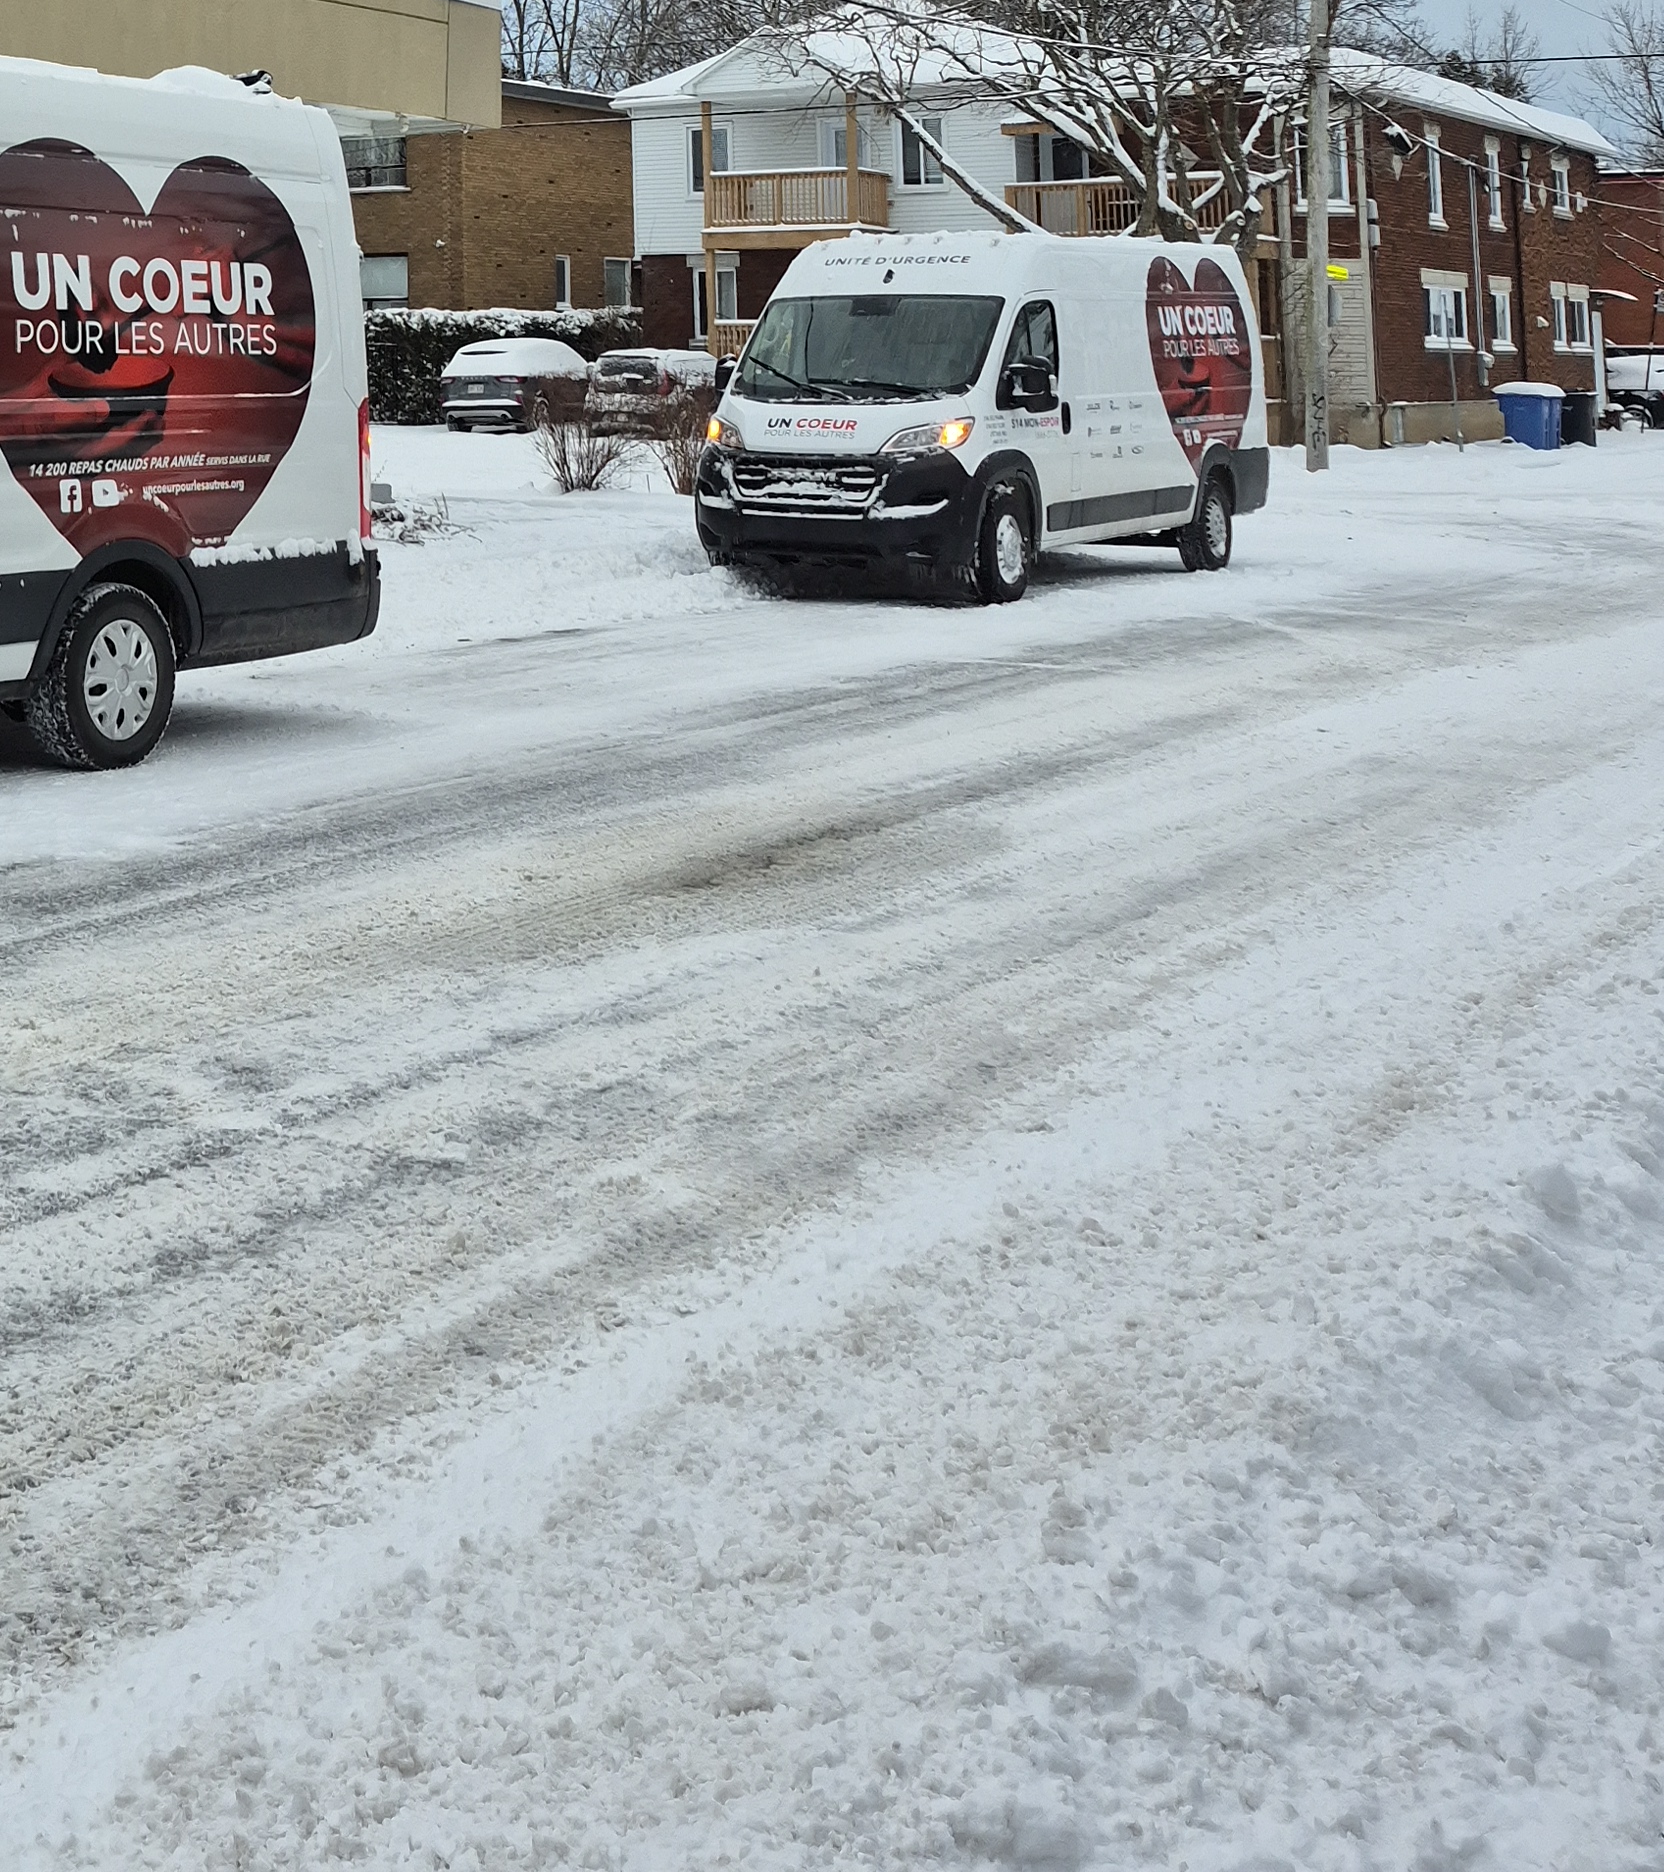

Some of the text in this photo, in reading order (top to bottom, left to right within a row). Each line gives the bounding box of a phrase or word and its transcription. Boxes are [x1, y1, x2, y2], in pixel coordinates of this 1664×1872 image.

[824, 255, 972, 266] UNITÉ D'URGENCE
[10, 251, 276, 316] UN COEUR
[1158, 306, 1237, 336] UN COEUR
[15, 319, 278, 356] POUR LES AUTRES
[1163, 339, 1240, 357] POUR LES AUTRES
[764, 429, 792, 437] POUR
[814, 431, 855, 440] AUTRES
[768, 418, 858, 430] UN COEUR
[29, 464, 44, 477] 14
[45, 462, 67, 476] 200
[68, 459, 104, 475] REPAS
[105, 457, 149, 472] CHAUDS
[149, 455, 170, 469] PAR
[169, 452, 206, 468] ANNÉE
